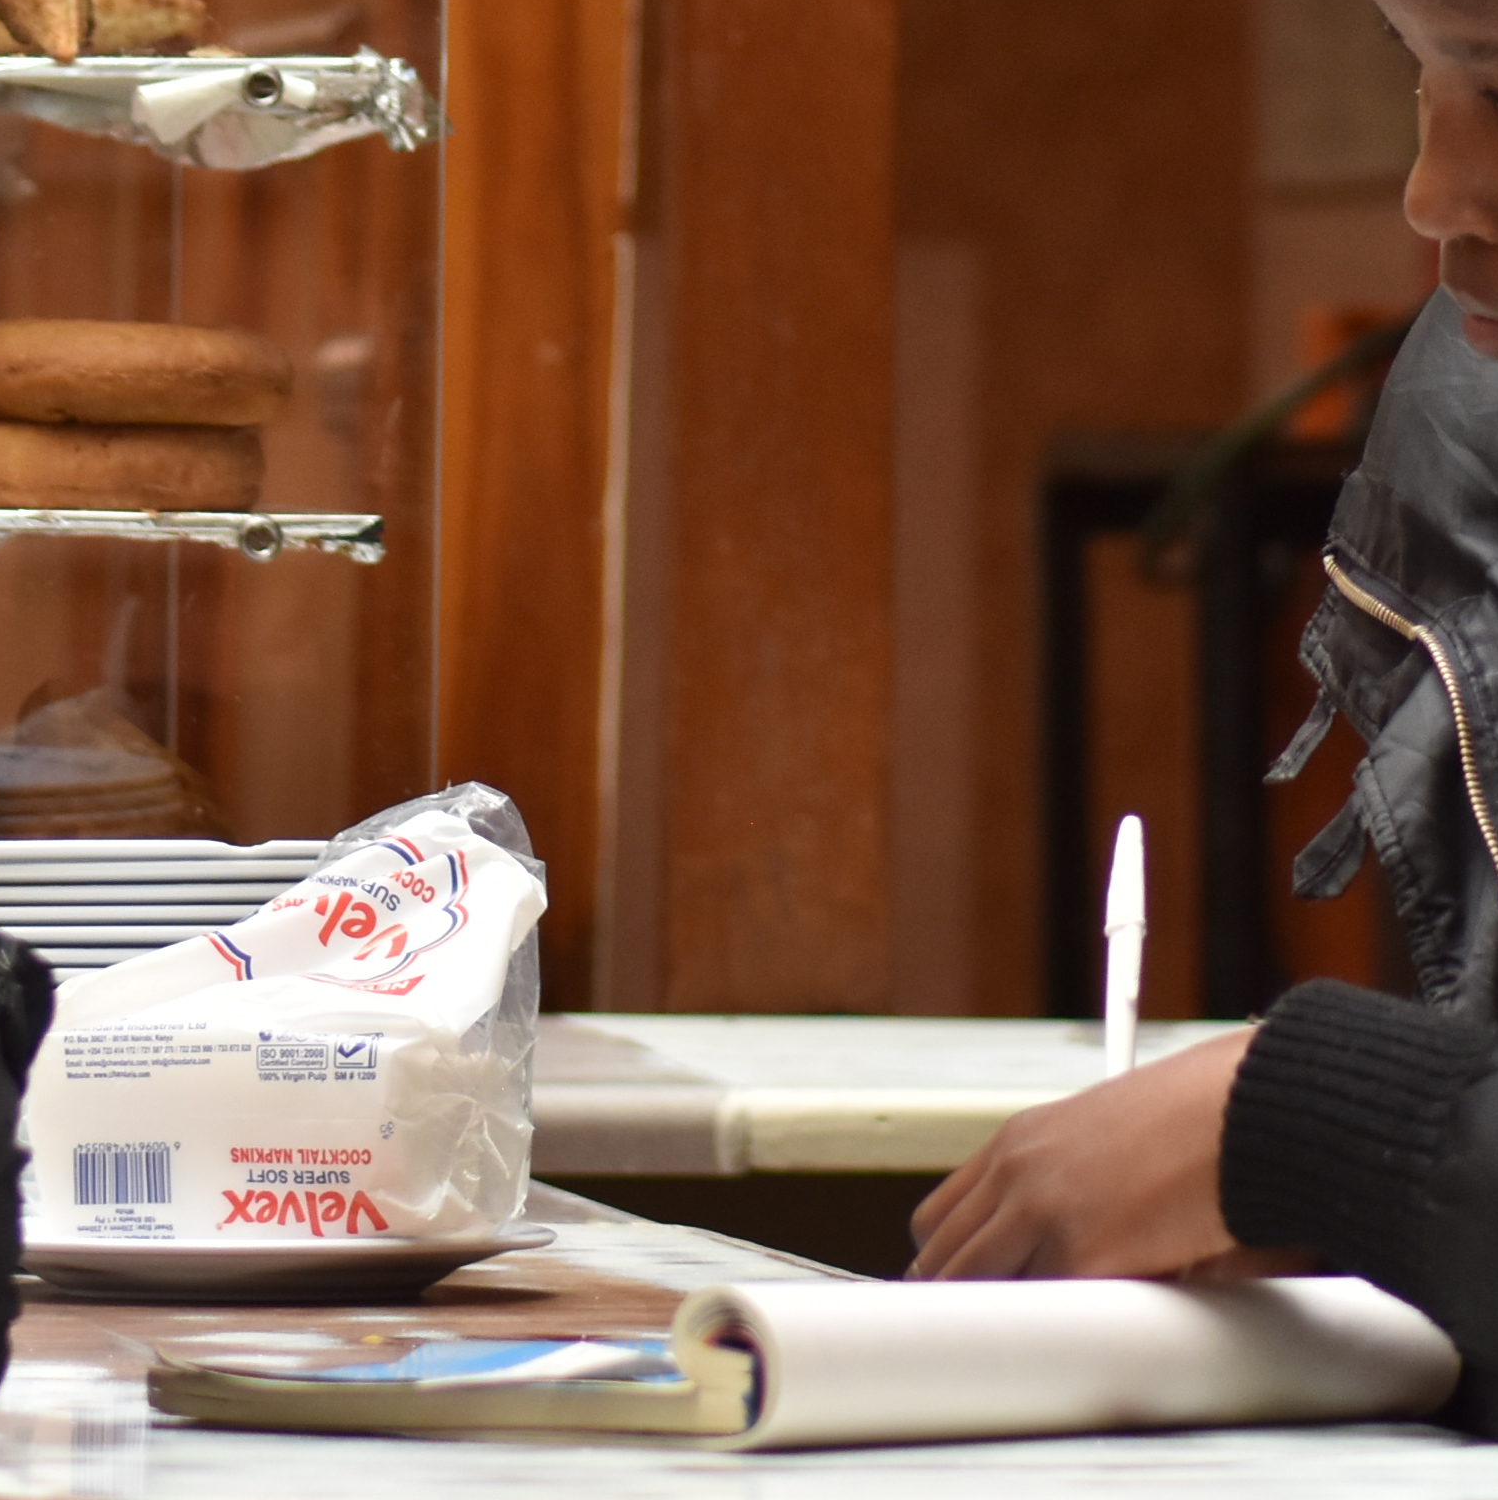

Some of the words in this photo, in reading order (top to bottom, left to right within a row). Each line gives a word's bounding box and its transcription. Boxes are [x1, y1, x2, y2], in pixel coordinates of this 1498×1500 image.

[260, 1048, 277, 1059] ISO
[260, 1059, 289, 1067] Certified
[290, 1059, 324, 1068] Company
[258, 1072, 280, 1082] 100%
[281, 1071, 306, 1083] Virgin
[307, 1071, 328, 1082] Pulp
[334, 1071, 347, 1081] SM
[229, 1147, 293, 1164] NAPKINS
[296, 1148, 372, 1166] COCKTAIL
[245, 1168, 289, 1184] SOFT
[292, 1170, 351, 1185] SUPER
[220, 1189, 390, 1238] Velvex
